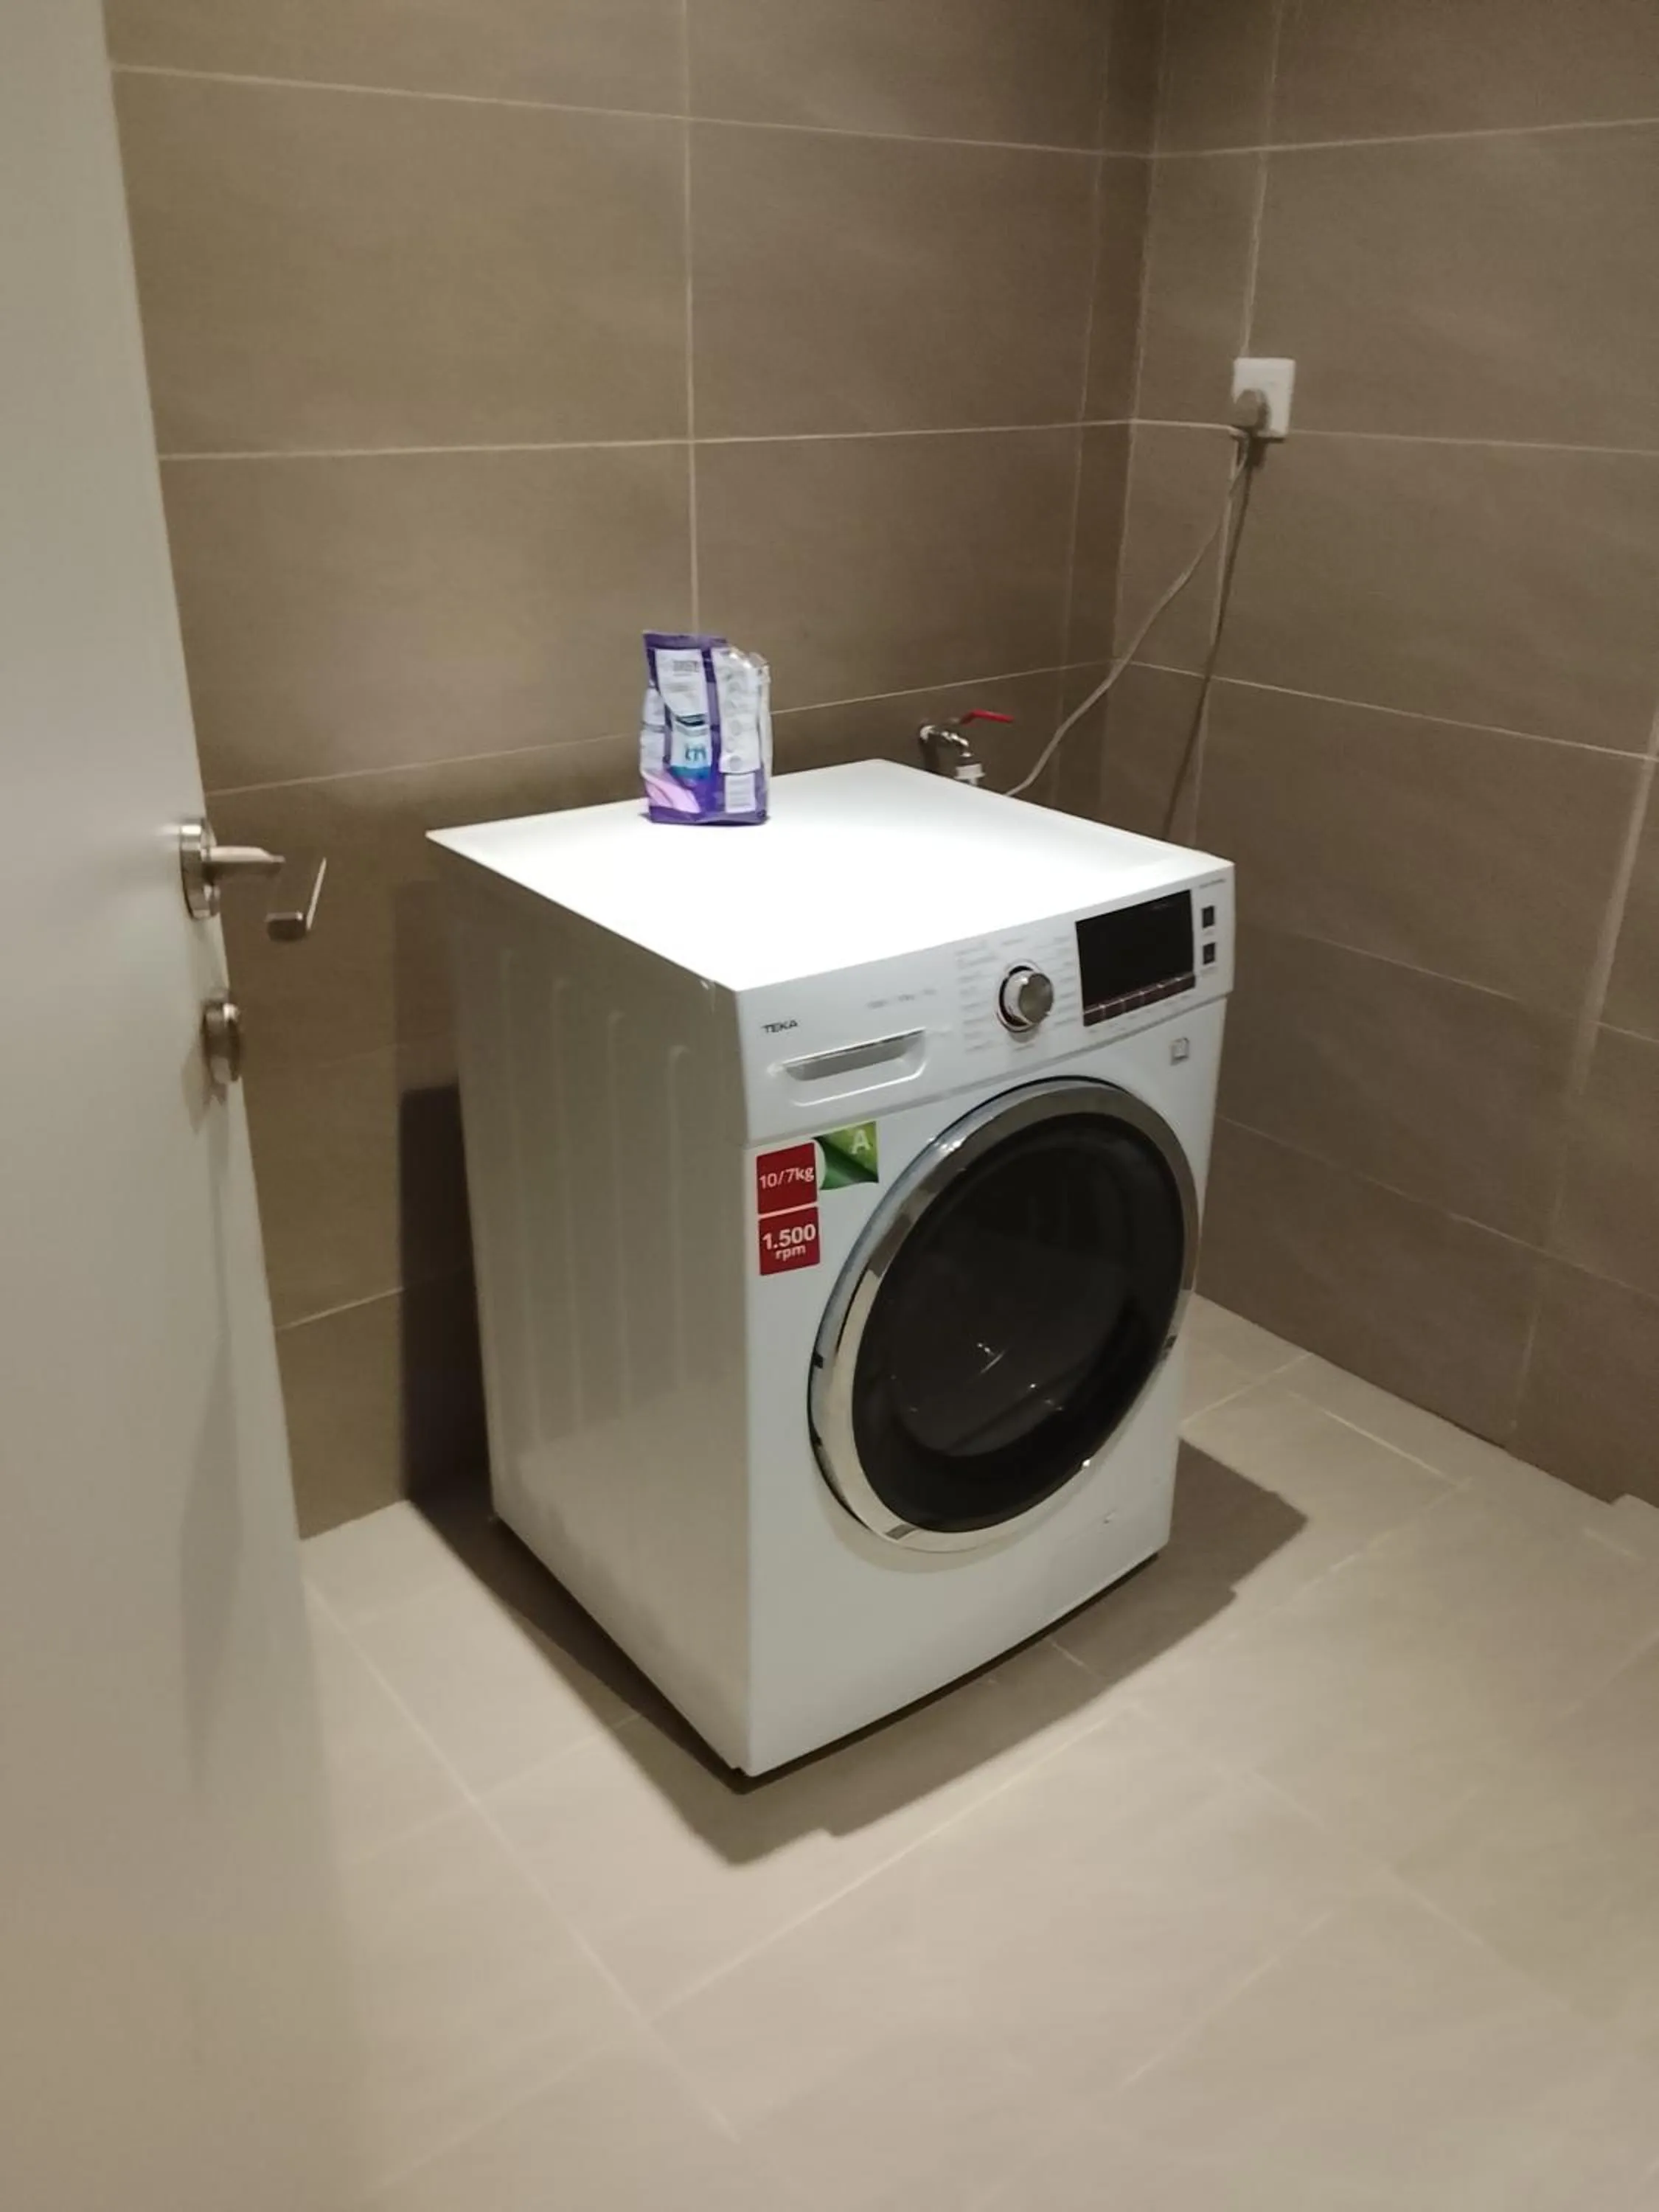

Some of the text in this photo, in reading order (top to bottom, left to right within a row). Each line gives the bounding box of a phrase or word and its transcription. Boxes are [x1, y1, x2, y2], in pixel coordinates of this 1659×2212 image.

[762, 1020, 798, 1033] TEKA
[852, 1129, 871, 1155] A
[759, 1166, 815, 1189] 10/7kg
[762, 1224, 816, 1250] 1.500
[775, 1245, 806, 1262] rpm
